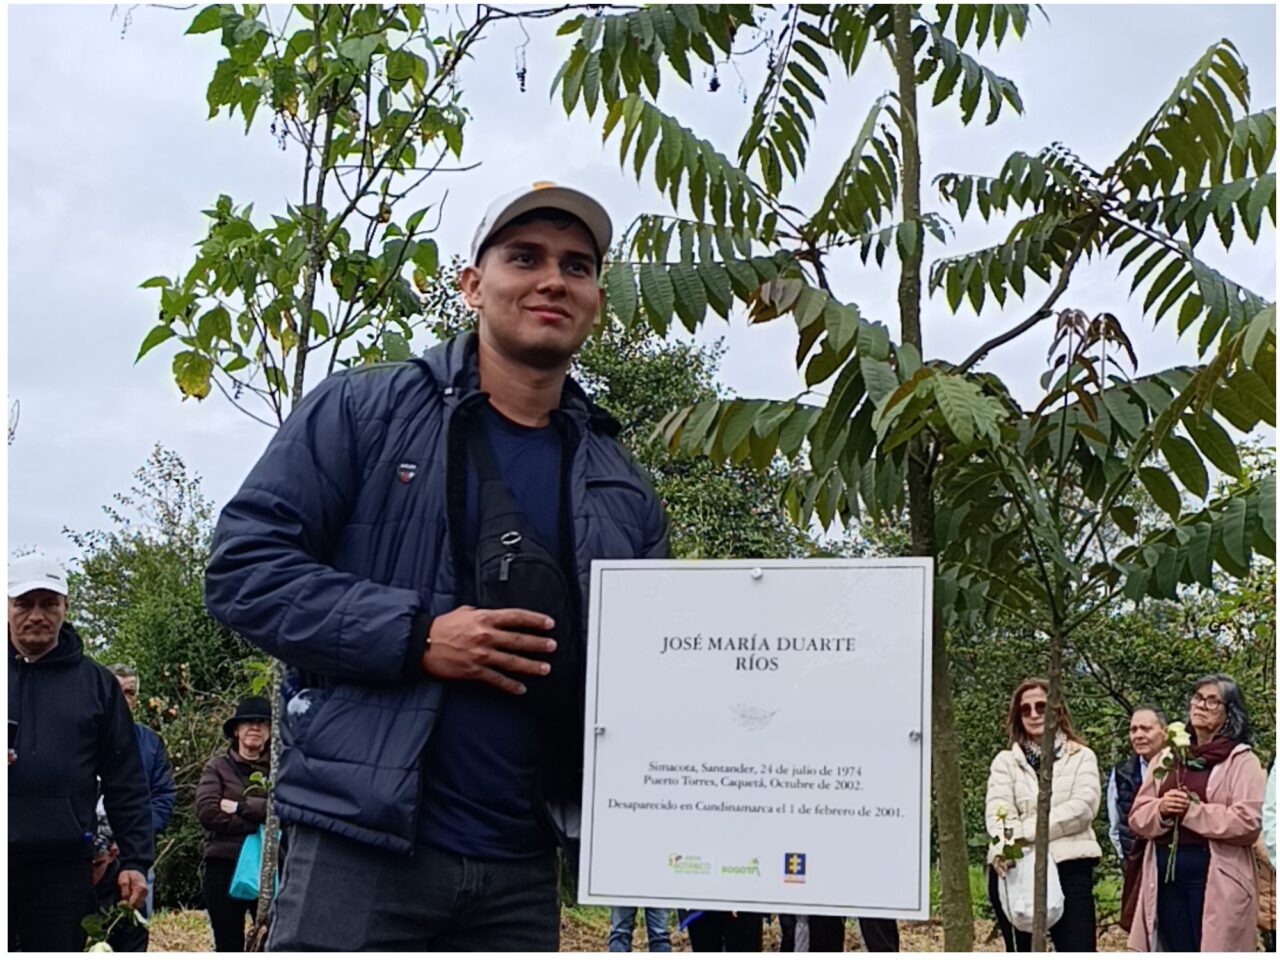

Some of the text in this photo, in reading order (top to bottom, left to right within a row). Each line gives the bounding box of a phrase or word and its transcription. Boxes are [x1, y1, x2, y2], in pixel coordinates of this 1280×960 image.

[660, 633, 856, 654] JOSÉ MARÍA DUARTE
[735, 653, 779, 671] RÍOS
[648, 761, 699, 773] Simacota,
[701, 762, 757, 775] Santander,
[775, 764, 789, 775] de
[791, 764, 817, 777] julio
[819, 765, 833, 776] de
[837, 766, 862, 777] 1974
[643, 775, 864, 791] Puerto Torres, Caquetá, Octubre de 2002.
[608, 798, 678, 812] Desaparecido
[680, 803, 693, 811] en
[695, 801, 773, 813] Cundinamarca
[776, 804, 787, 814] el
[798, 804, 812, 815] de
[814, 805, 855, 816] febrero
[857, 806, 872, 817] de
[875, 807, 905, 818] 2001.
